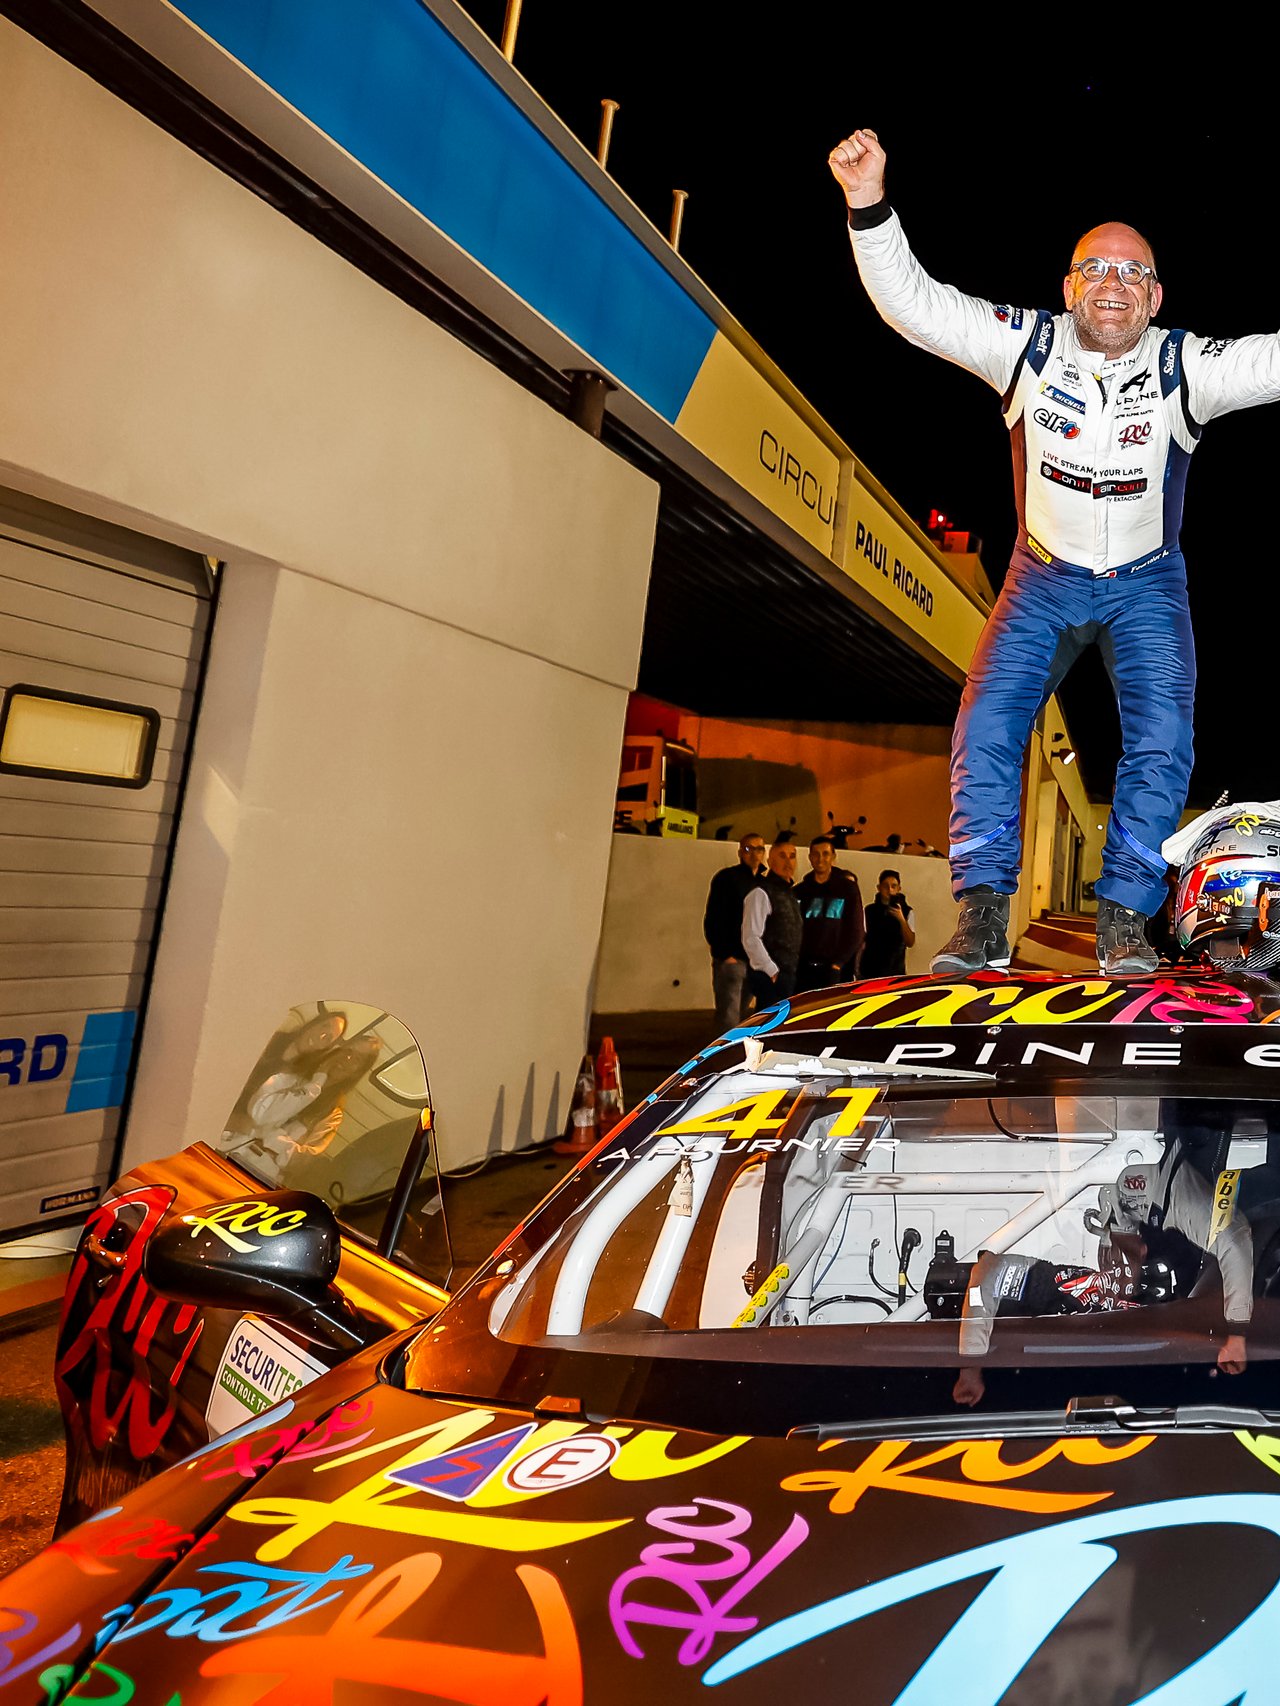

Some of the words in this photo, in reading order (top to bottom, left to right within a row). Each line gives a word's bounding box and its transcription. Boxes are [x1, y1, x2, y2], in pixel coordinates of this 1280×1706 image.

[1036, 322, 1052, 355] Sabelt
[1163, 340, 1178, 376] Sabelt
[1116, 391, 1159, 405] LPINE
[1033, 408, 1068, 433] elf
[1043, 450, 1059, 464] LIVE
[1060, 460, 1093, 474] STREAM
[1099, 469, 1121, 477] YOUR
[1122, 467, 1143, 476] LAPS
[855, 520, 889, 578] PAUL
[892, 557, 934, 617] RICARD
[650, 1087, 881, 1139] 41
[222, 1370, 255, 1406] CONTROLE
